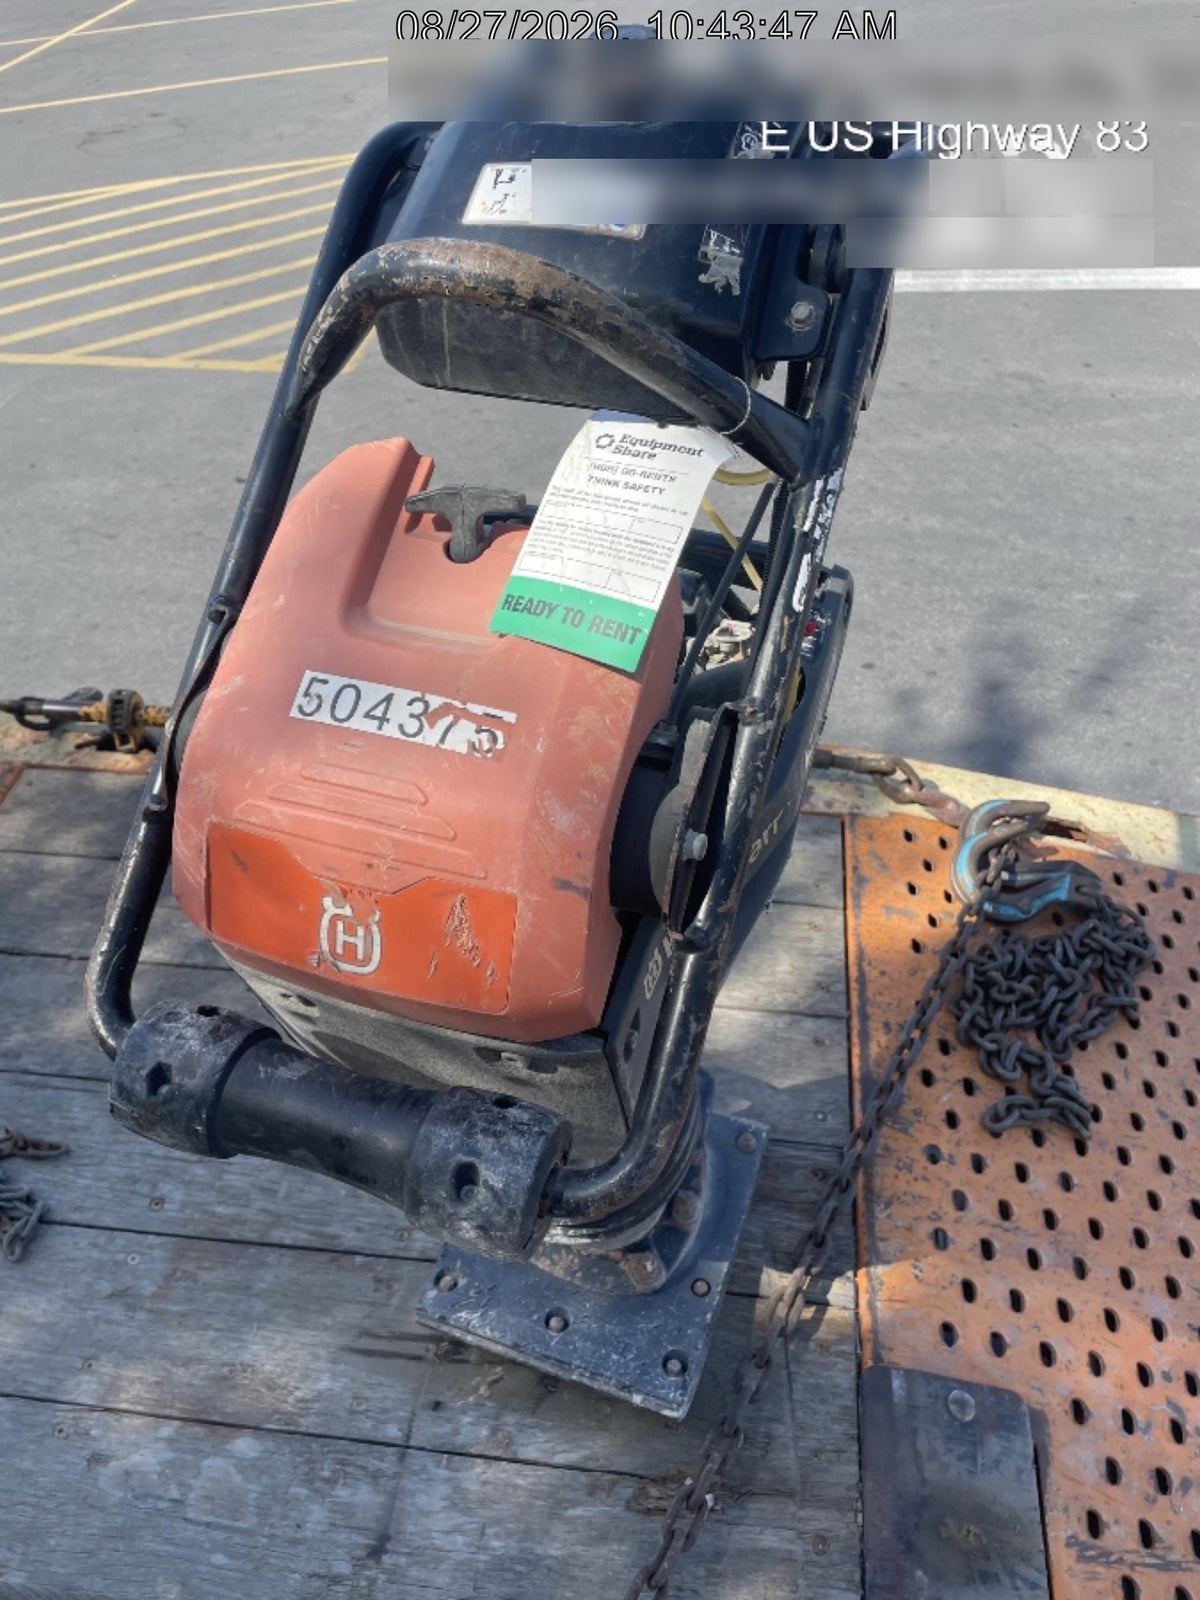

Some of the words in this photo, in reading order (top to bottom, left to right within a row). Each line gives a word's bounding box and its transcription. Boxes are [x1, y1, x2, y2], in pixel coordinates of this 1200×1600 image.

[613, 445, 657, 460] Share
[618, 434, 704, 457] Equipment
[622, 481, 667, 495] SAFETY
[502, 593, 559, 620] READY
[562, 604, 586, 628] TO
[588, 614, 643, 645] RENT
